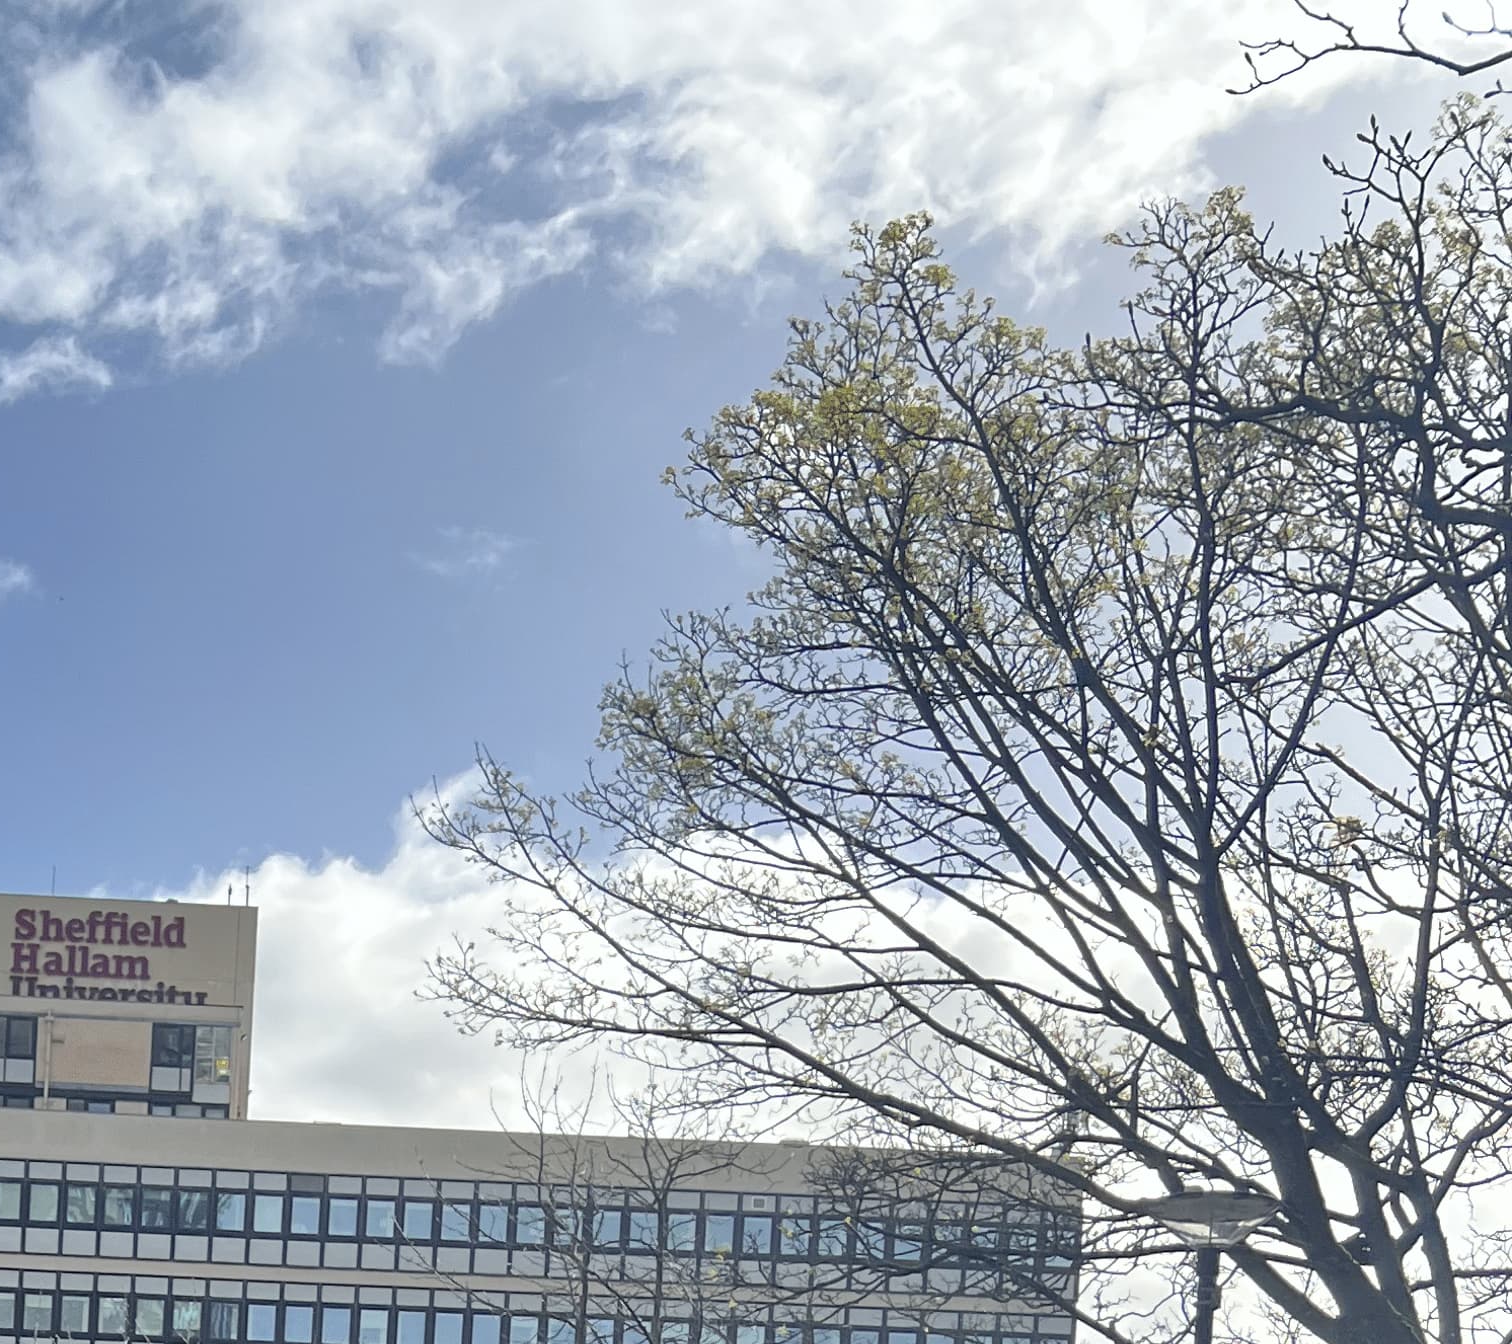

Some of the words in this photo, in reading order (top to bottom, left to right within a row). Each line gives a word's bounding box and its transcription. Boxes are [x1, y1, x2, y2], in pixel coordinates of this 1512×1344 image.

[15, 908, 186, 948] Sheffield
[10, 943, 151, 980] Hallam
[9, 976, 208, 1006] University
